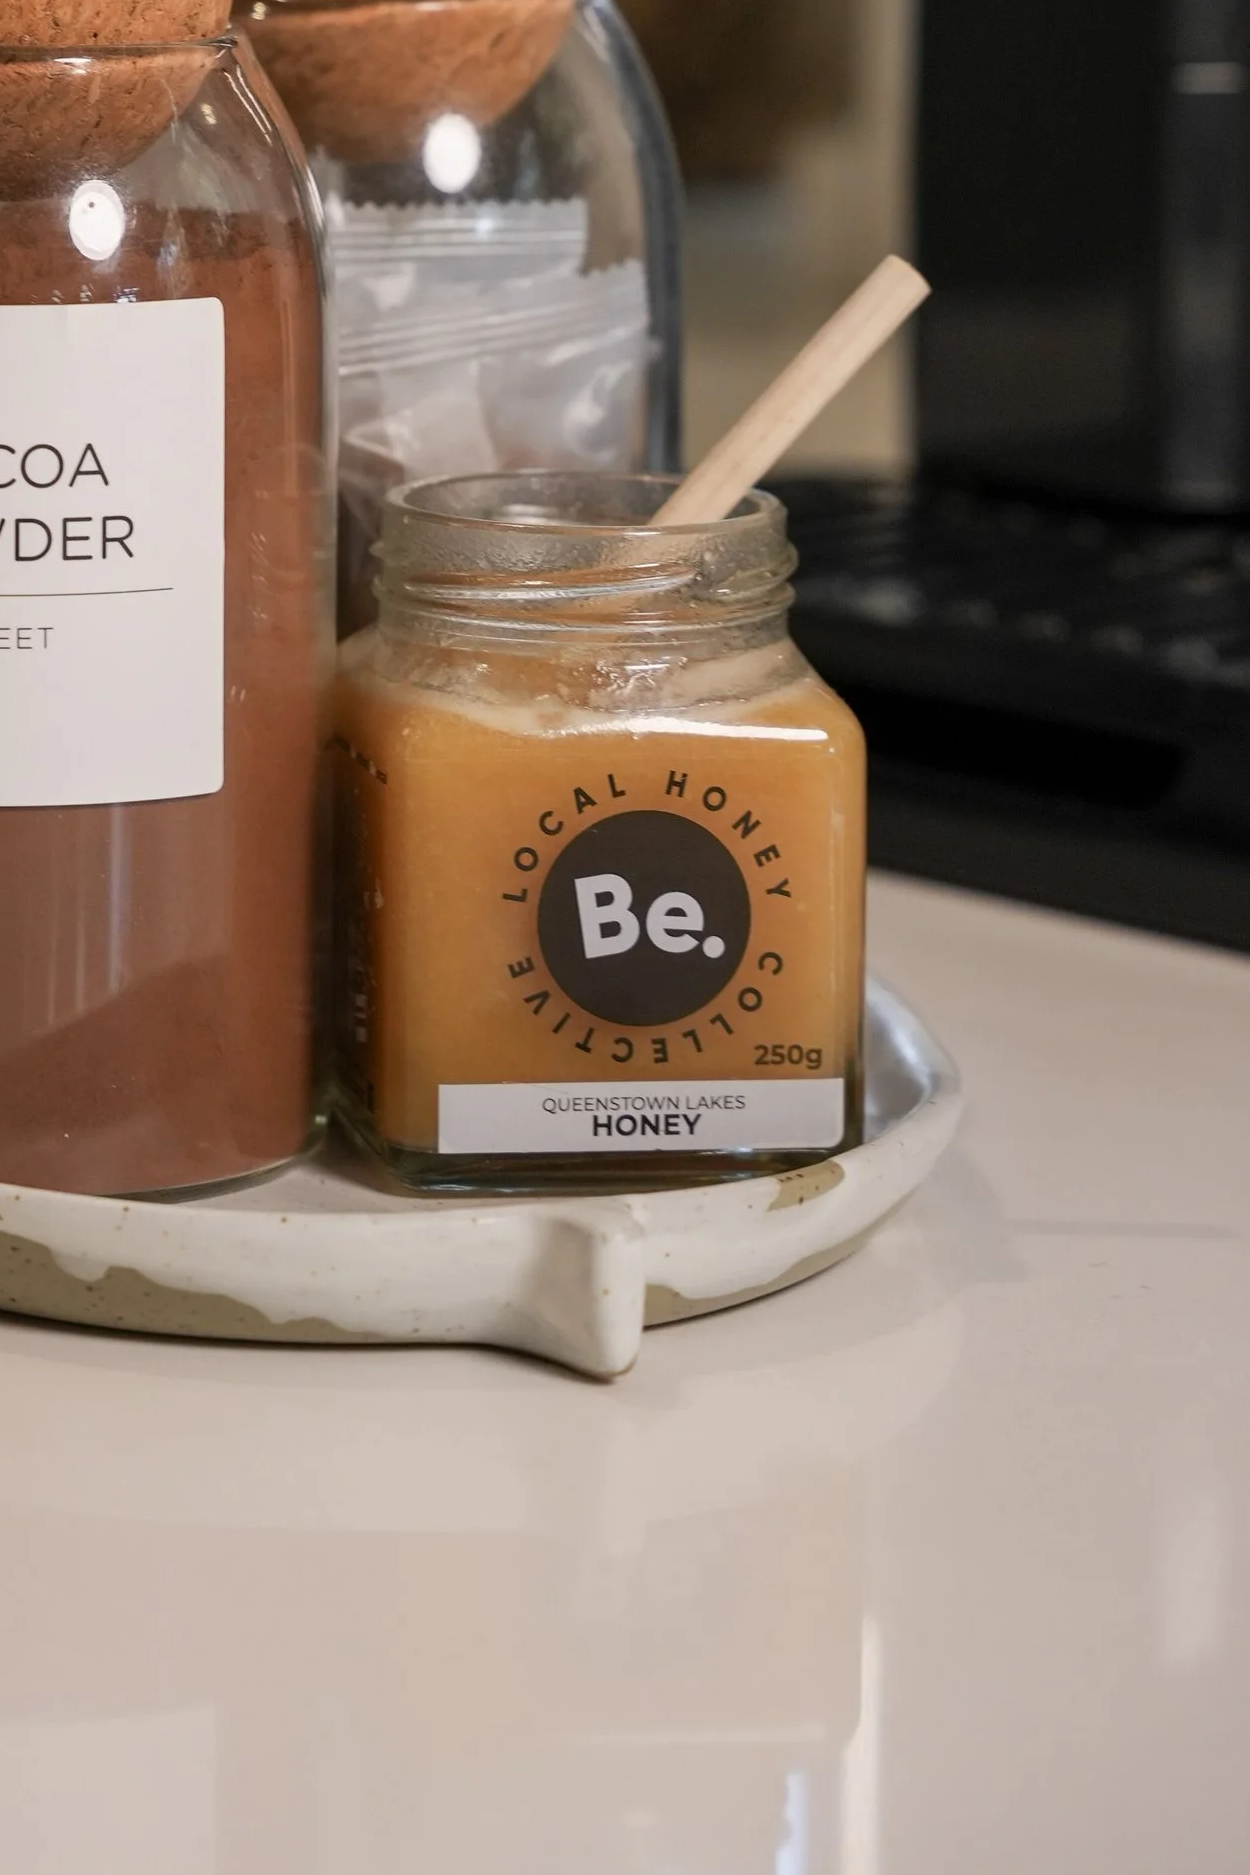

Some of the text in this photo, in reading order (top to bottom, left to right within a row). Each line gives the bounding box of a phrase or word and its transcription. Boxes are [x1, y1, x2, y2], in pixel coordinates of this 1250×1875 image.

[502, 770, 792, 1064] LOCAL HONEY COLLECTIVE
[573, 872, 726, 960] Be.
[752, 1043, 824, 1071] 250g
[541, 1095, 747, 1115] QUEENSTOWN LAKES
[591, 1113, 703, 1138] HONEY
